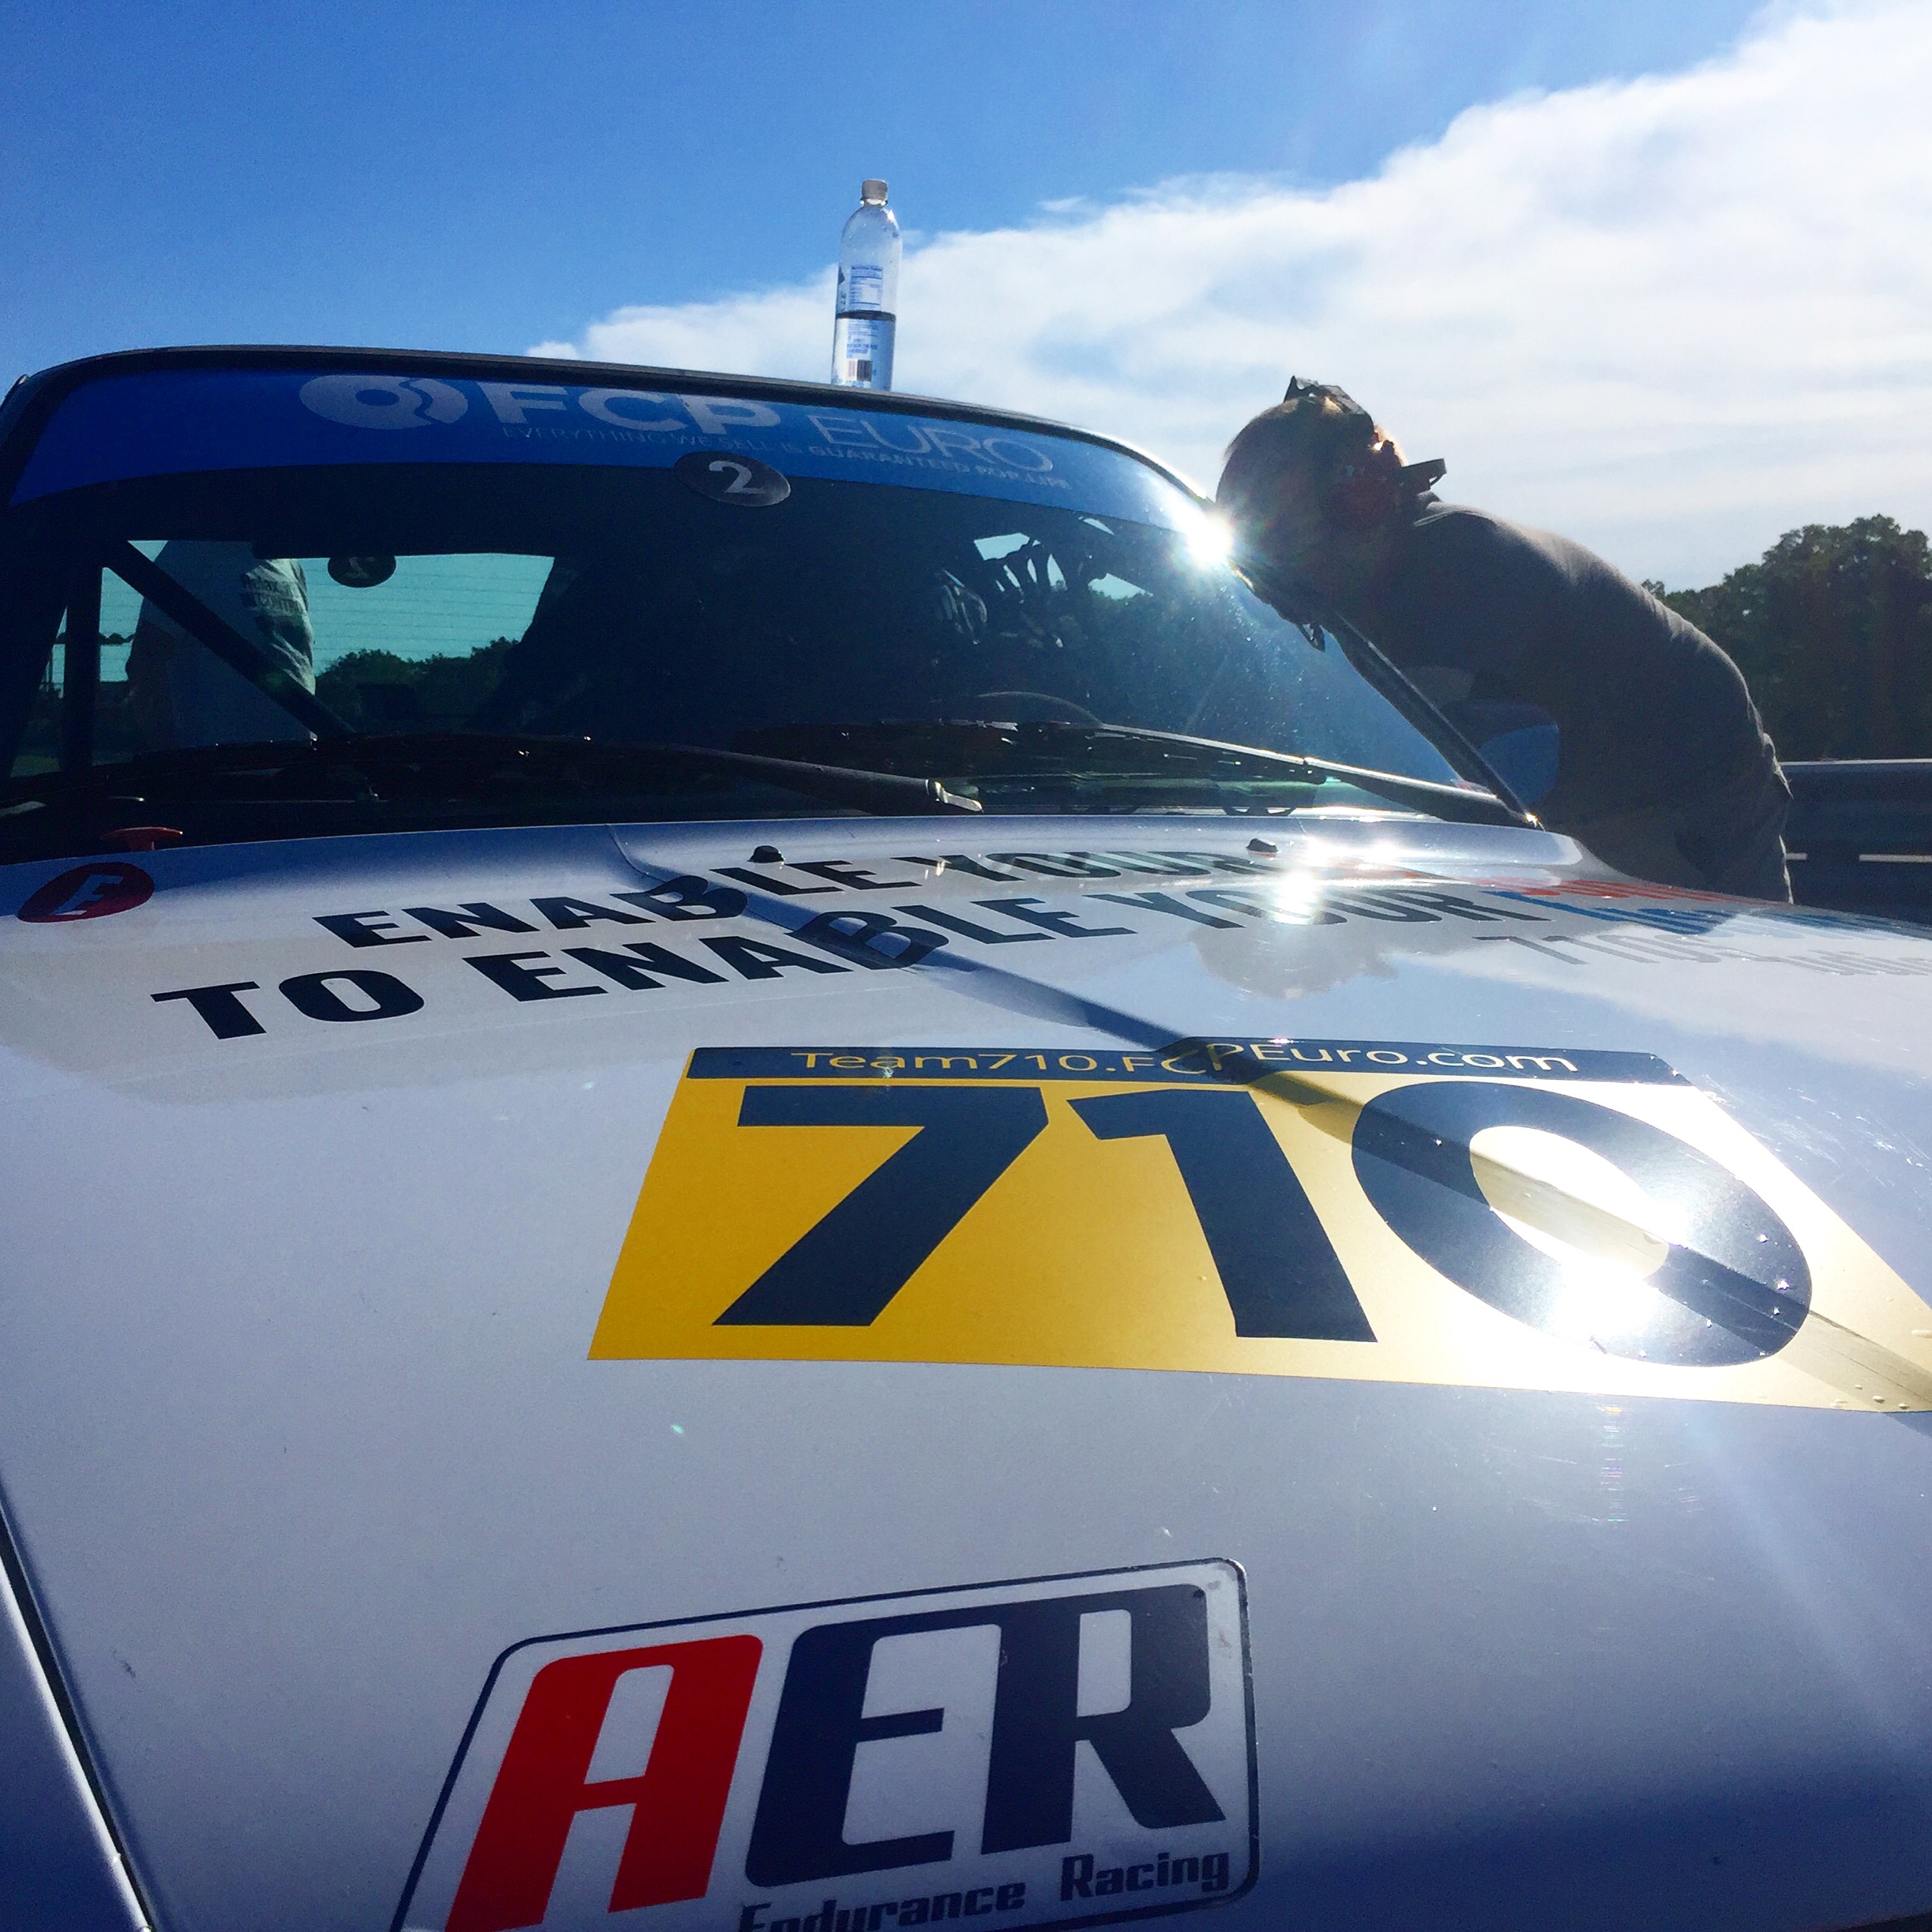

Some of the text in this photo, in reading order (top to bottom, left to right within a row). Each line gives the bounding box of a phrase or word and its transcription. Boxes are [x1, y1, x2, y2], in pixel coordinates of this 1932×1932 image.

[475, 381, 1054, 473] FCP EURO
[709, 460, 766, 495] 2
[313, 851, 1284, 948] ENABLE YOUR
[150, 969, 425, 1040] TO
[462, 897, 1138, 1002] ENABLE
[1088, 889, 1551, 929] YOUR
[791, 1043, 1579, 1074] Team710.FCPEuro.com
[711, 1081, 1813, 1368] 710
[444, 1583, 1226, 1932] AER
[1060, 1851, 1231, 1902] Racing
